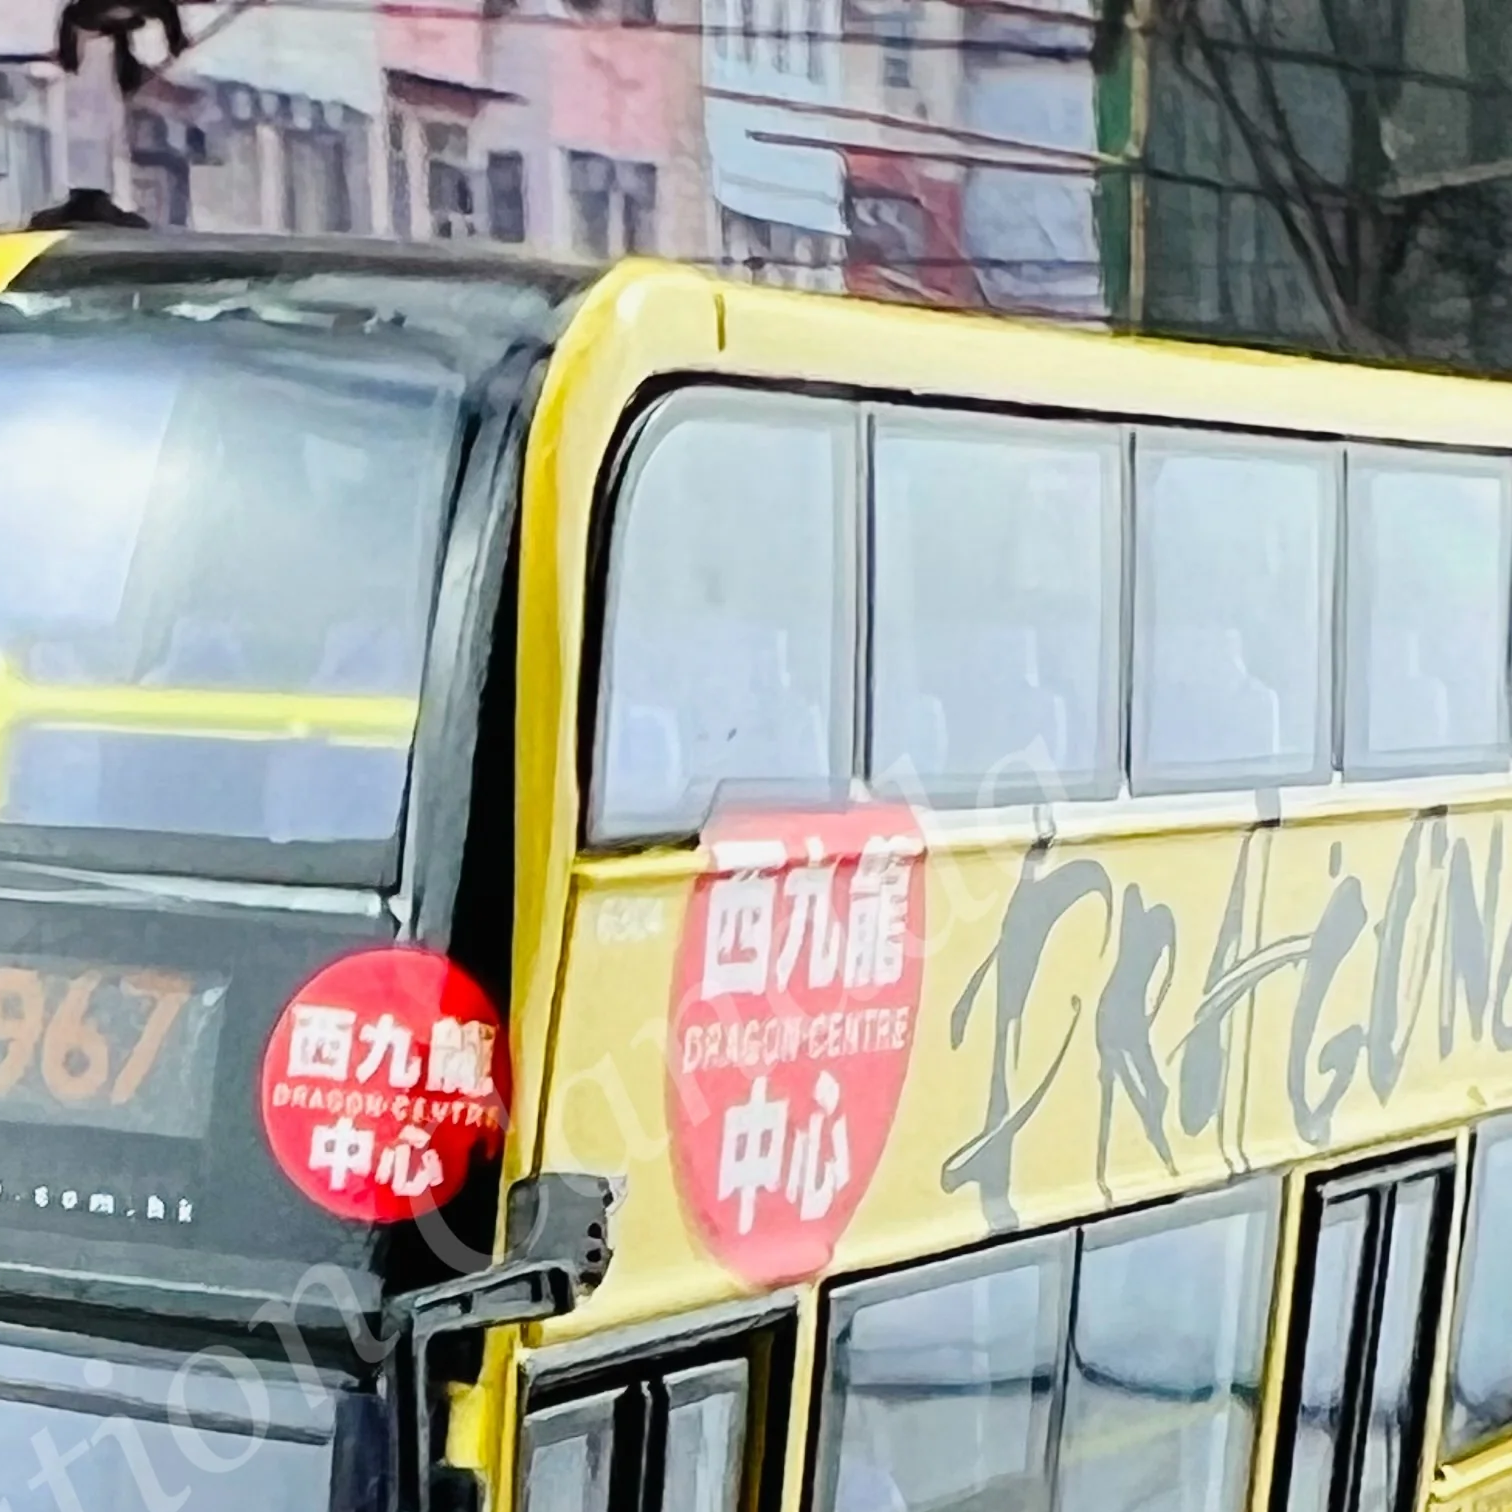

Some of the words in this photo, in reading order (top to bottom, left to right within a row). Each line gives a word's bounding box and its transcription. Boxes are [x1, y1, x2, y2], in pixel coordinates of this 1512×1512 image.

[699, 835, 926, 1000] 西九龍
[288, 1003, 496, 1098] 西九龍
[308, 1117, 444, 1197] 中心
[717, 1069, 850, 1235] 中心
